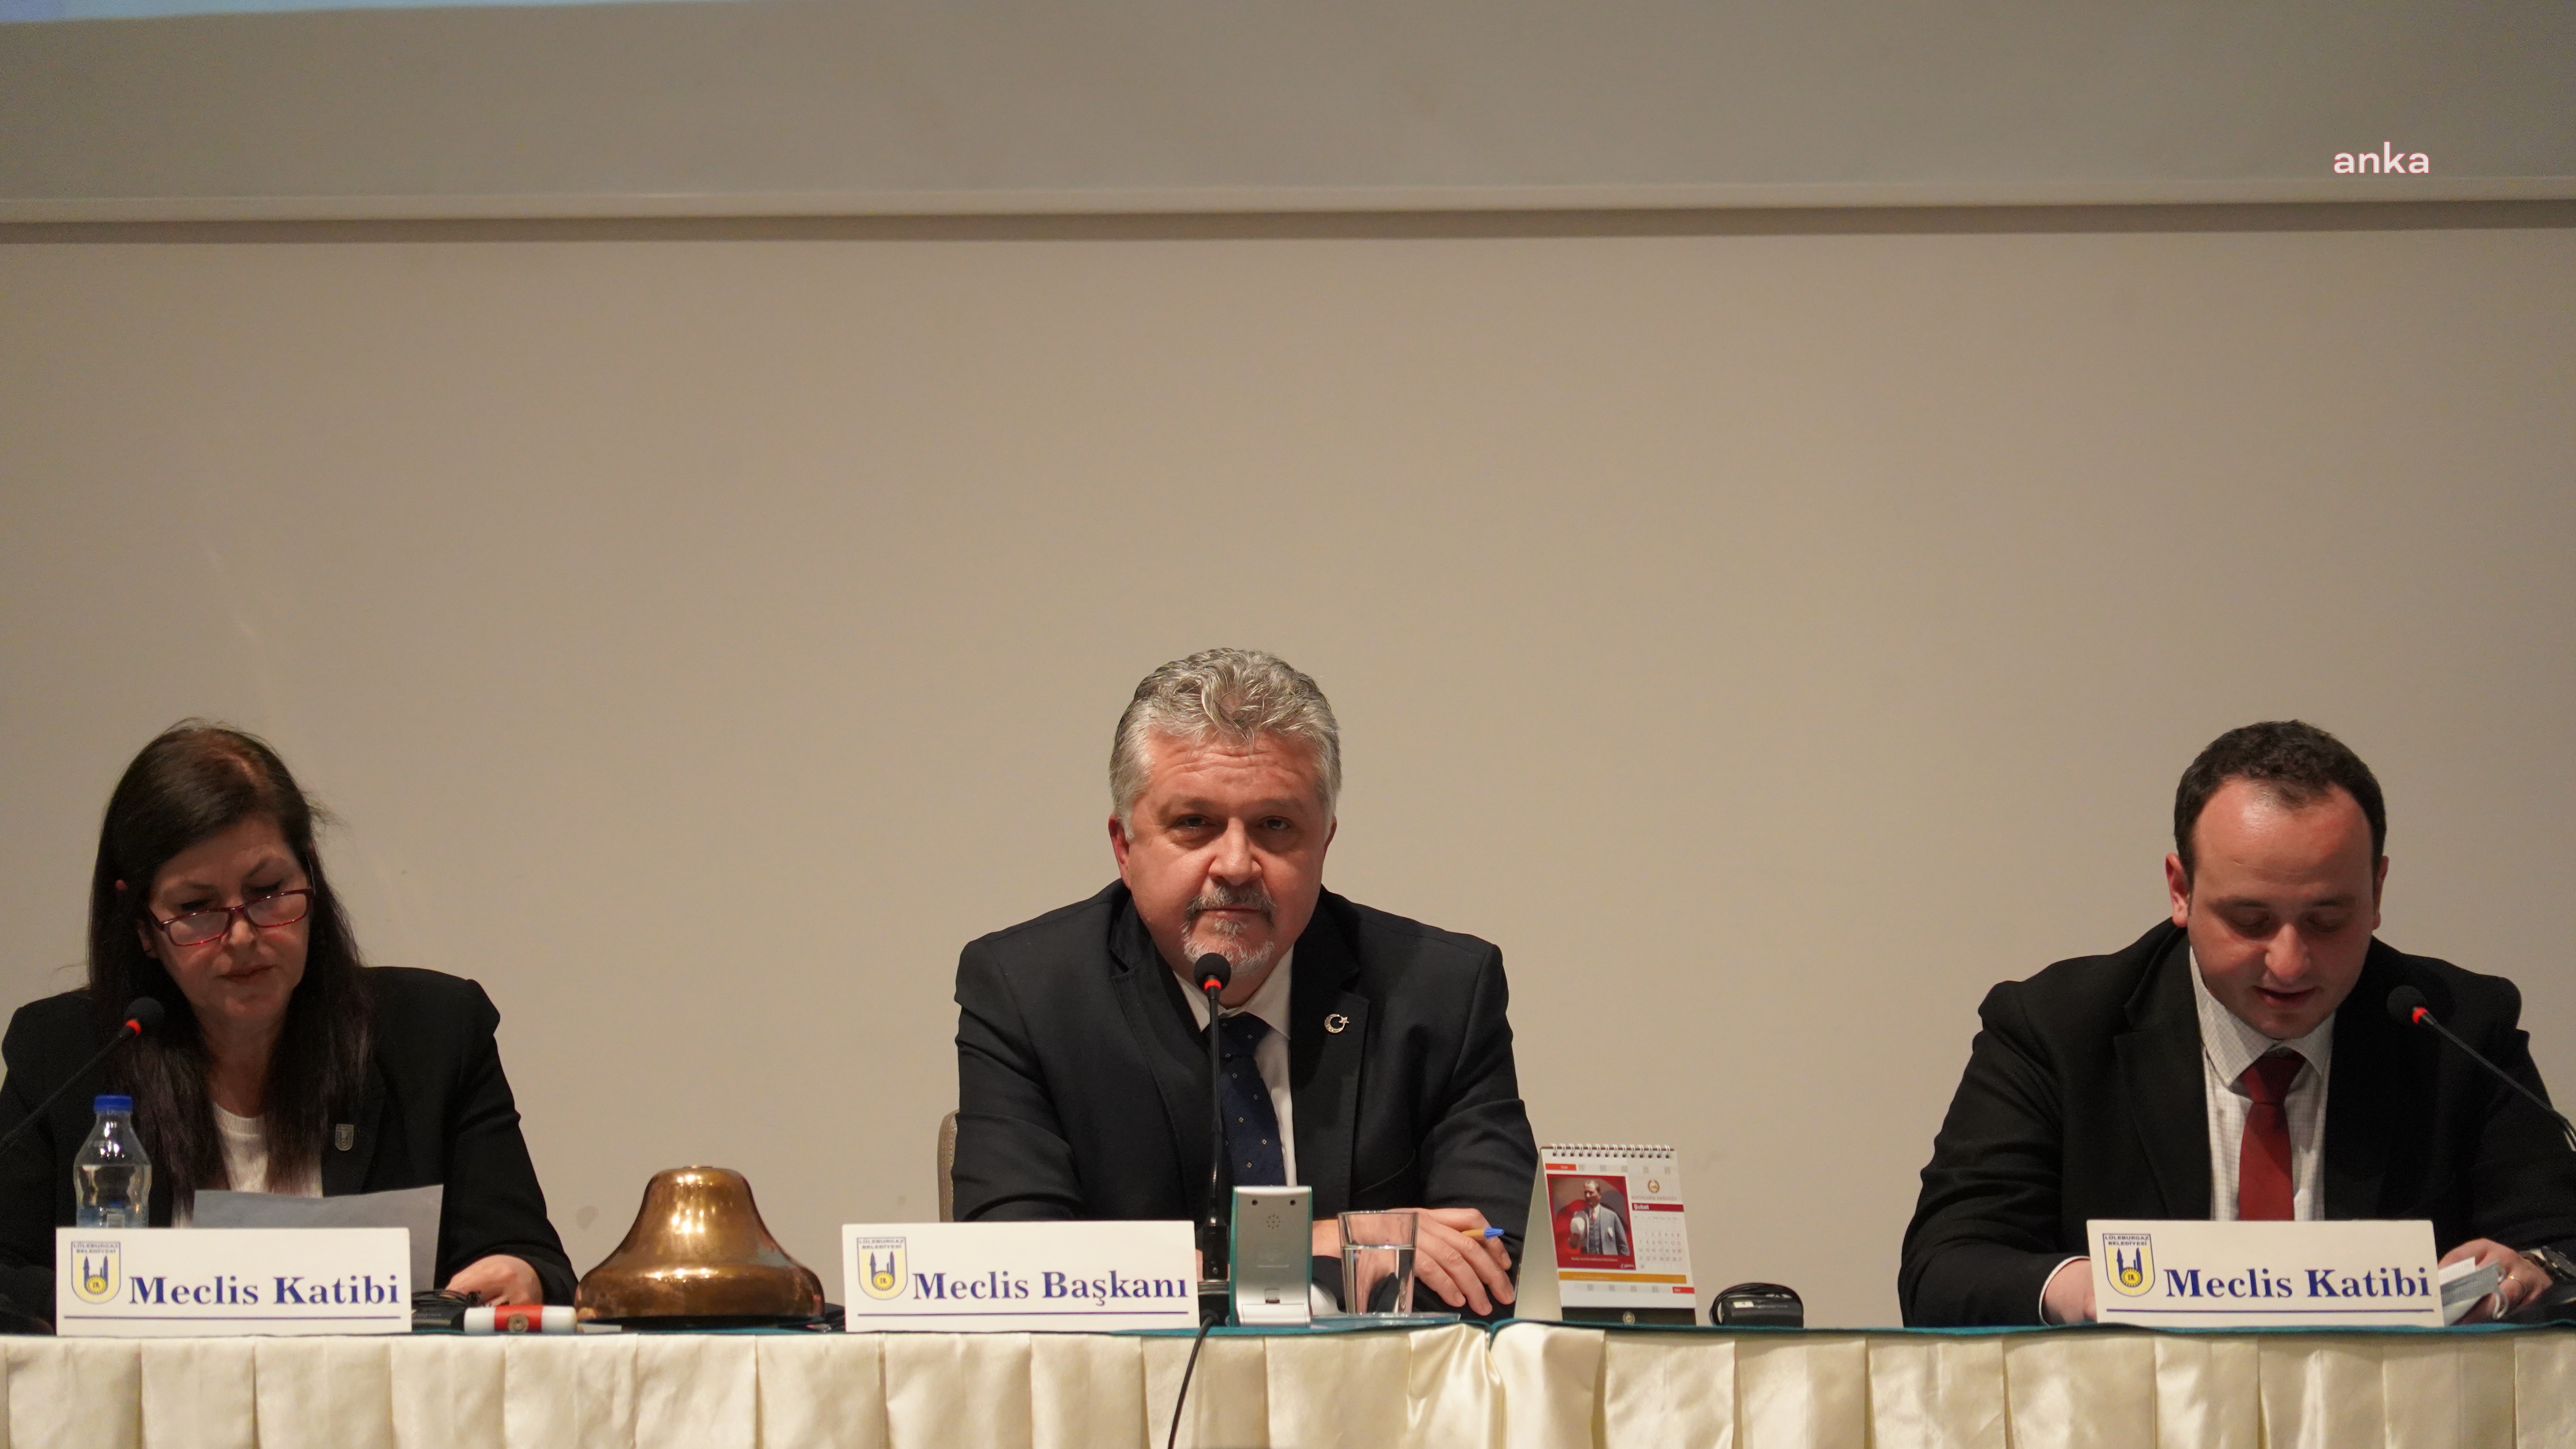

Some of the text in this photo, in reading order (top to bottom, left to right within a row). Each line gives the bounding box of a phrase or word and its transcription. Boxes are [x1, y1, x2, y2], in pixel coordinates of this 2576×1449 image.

[130, 1275, 400, 1305] Meclis Katibi
[913, 1270, 1188, 1306] Meclis Başkanı
[2164, 1267, 2432, 1298] Meclis Katibi
